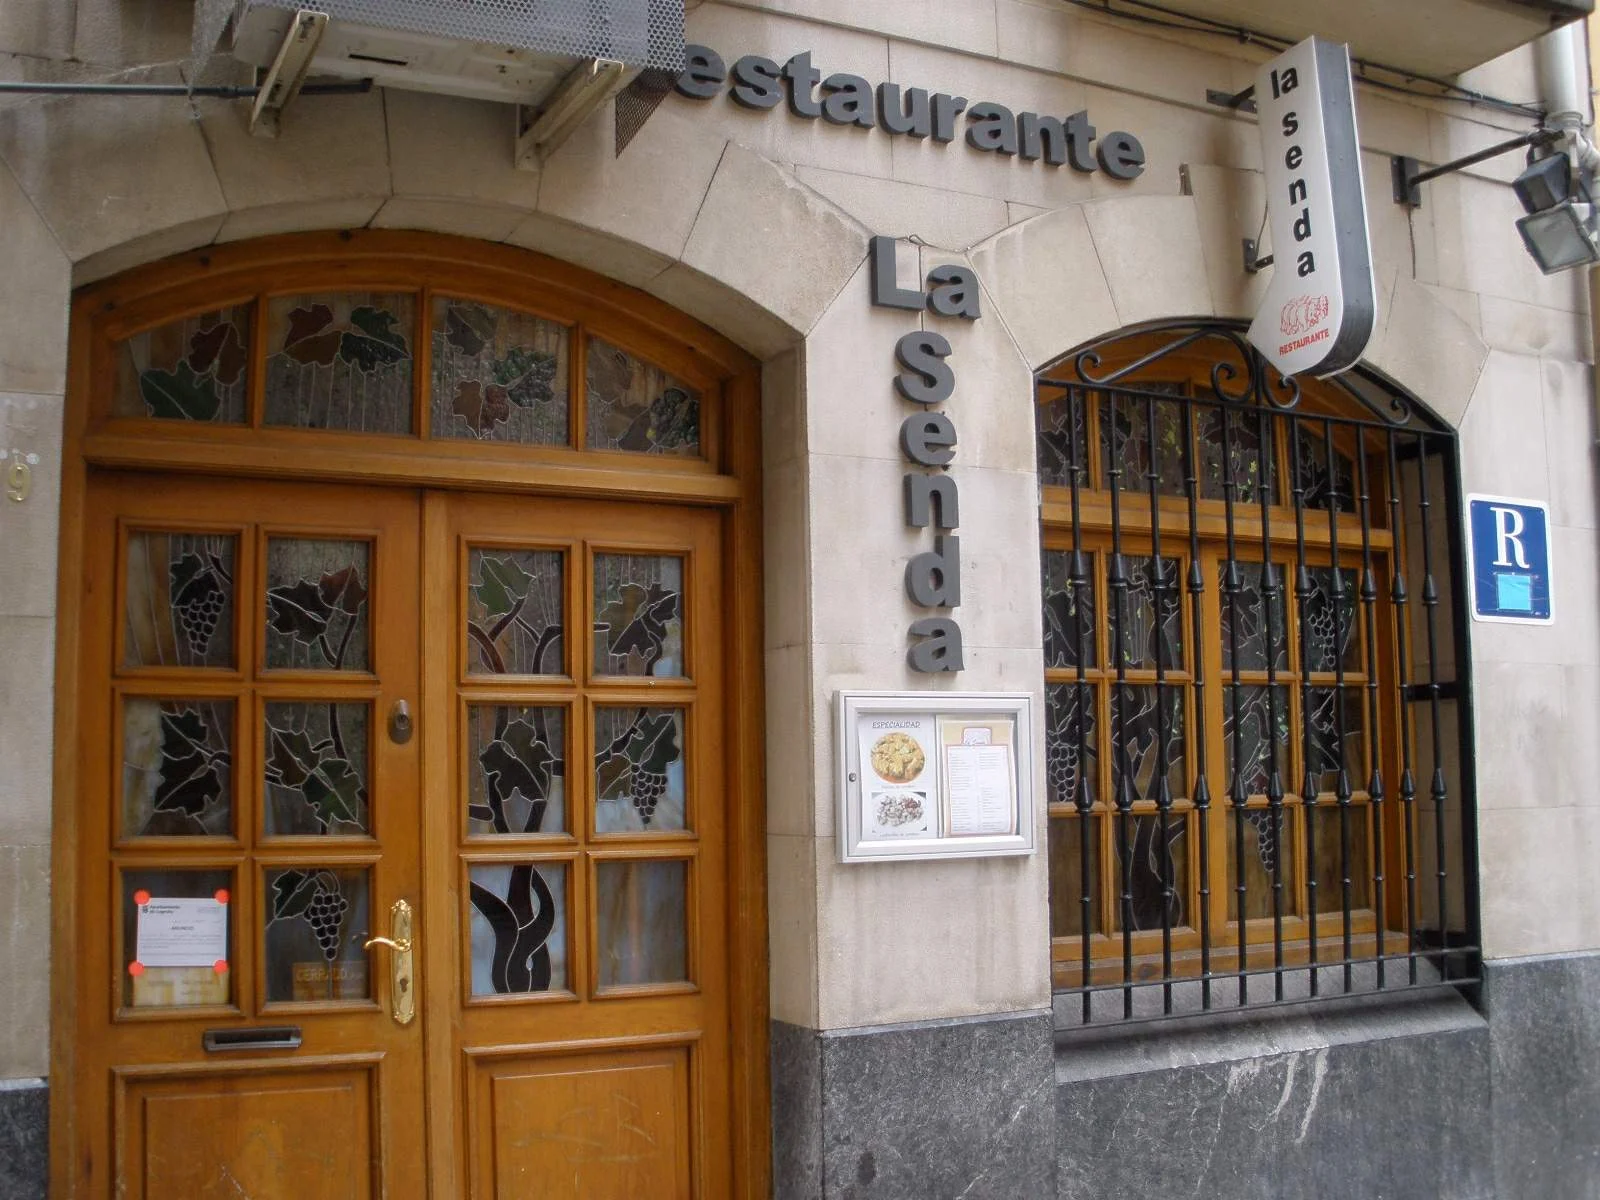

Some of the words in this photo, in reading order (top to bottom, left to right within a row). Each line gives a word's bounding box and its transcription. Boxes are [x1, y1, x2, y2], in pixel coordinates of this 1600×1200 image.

[674, 45, 1146, 180] estaurante
[1270, 65, 1299, 100] la
[1281, 109, 1316, 278] senda
[869, 235, 982, 320] La
[1279, 328, 1329, 356] RESTAURANTE
[7, 463, 32, 502] 9
[893, 330, 965, 673] Senda
[1489, 506, 1531, 569] R
[872, 720, 921, 729] ESPECIALIDAD
